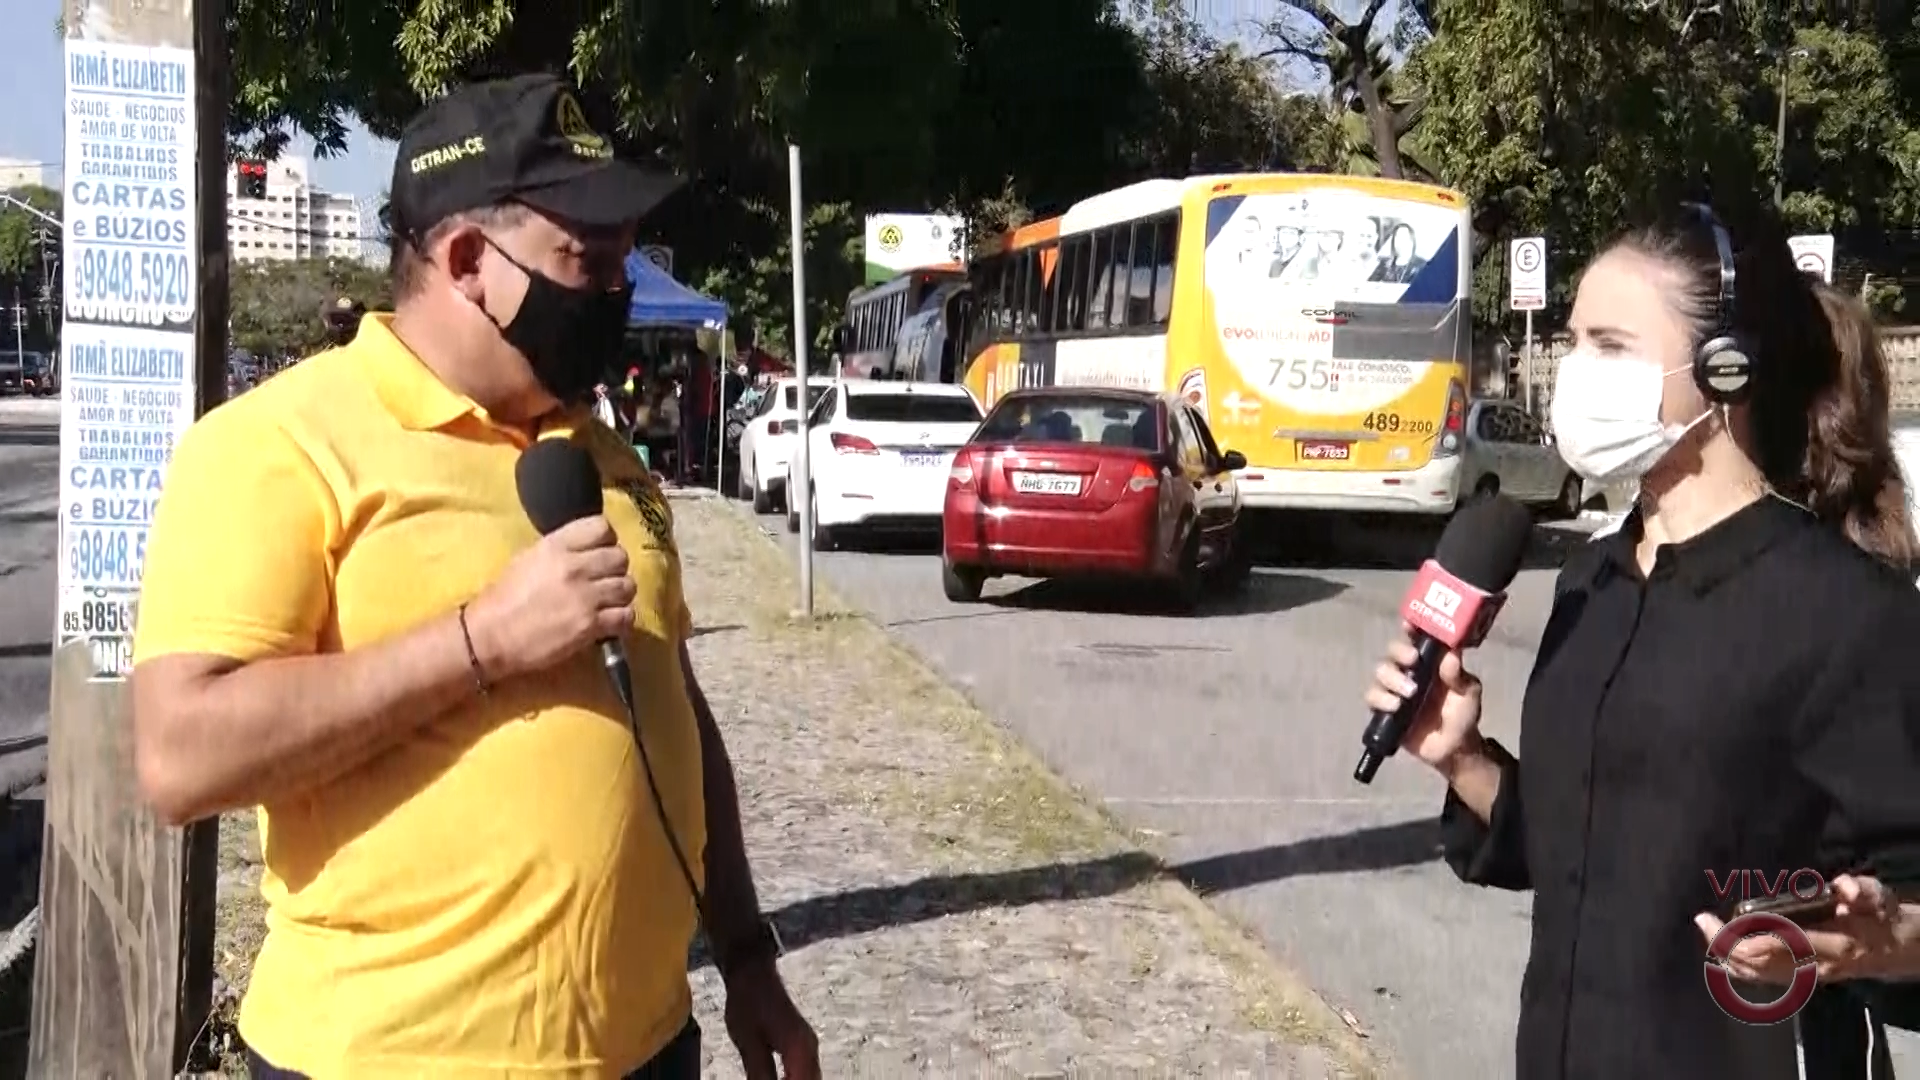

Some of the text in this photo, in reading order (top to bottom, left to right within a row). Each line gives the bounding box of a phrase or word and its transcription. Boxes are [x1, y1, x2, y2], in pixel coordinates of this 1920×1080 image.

[70, 51, 186, 94] IRMÃ ELIZABETH
[80, 119, 176, 142] AMOR DE VOLTA
[80, 142, 178, 164] TRABALHOS
[411, 136, 485, 174] DETRAN-CE
[81, 160, 178, 181] GARANTIDOS
[72, 181, 186, 211] CARTAS
[73, 211, 186, 243] e BÚZIOS
[70, 340, 184, 380] IRMÃ ELIZABETH
[79, 406, 174, 424] AMOR DE VOLTA
[78, 428, 174, 446] TRABALHOS
[79, 445, 173, 464] GARANTIDOS
[70, 466, 163, 491] CARTA
[70, 492, 160, 521] e BÚZI
[1435, 589, 1455, 608] TV
